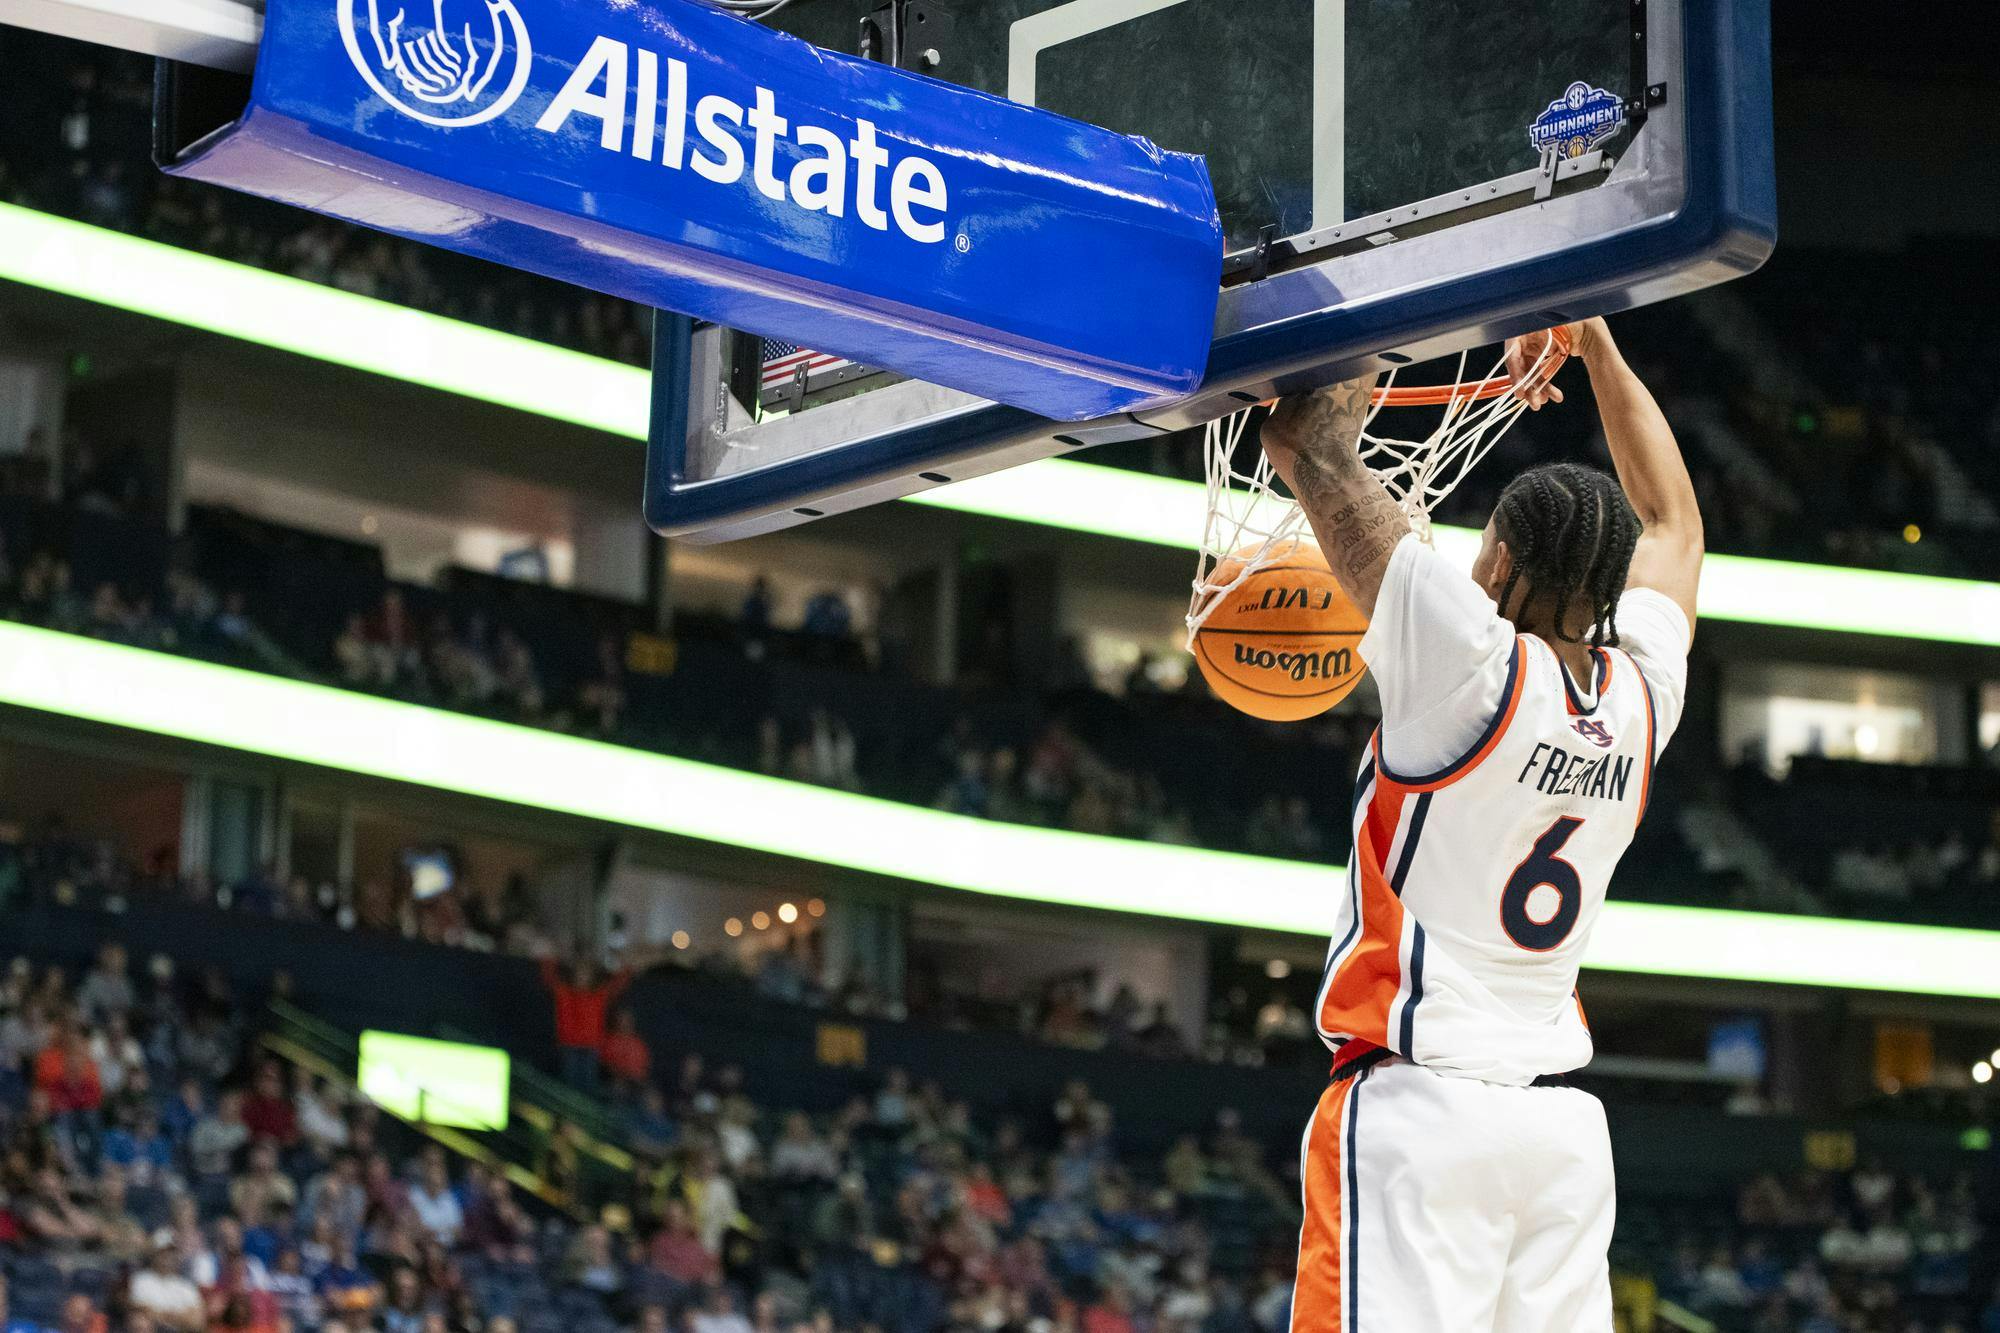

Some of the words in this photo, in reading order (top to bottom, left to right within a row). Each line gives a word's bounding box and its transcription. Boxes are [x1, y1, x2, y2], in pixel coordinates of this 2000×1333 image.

[1568, 87, 1586, 110] SEC
[535, 35, 948, 243] Allstate
[1532, 104, 1622, 143] TOURNAMENT
[1342, 528, 1365, 552] ONLY
[1365, 515, 1385, 533] CAN
[1234, 643, 1352, 681] Wilson
[1500, 815, 1585, 952] 6
